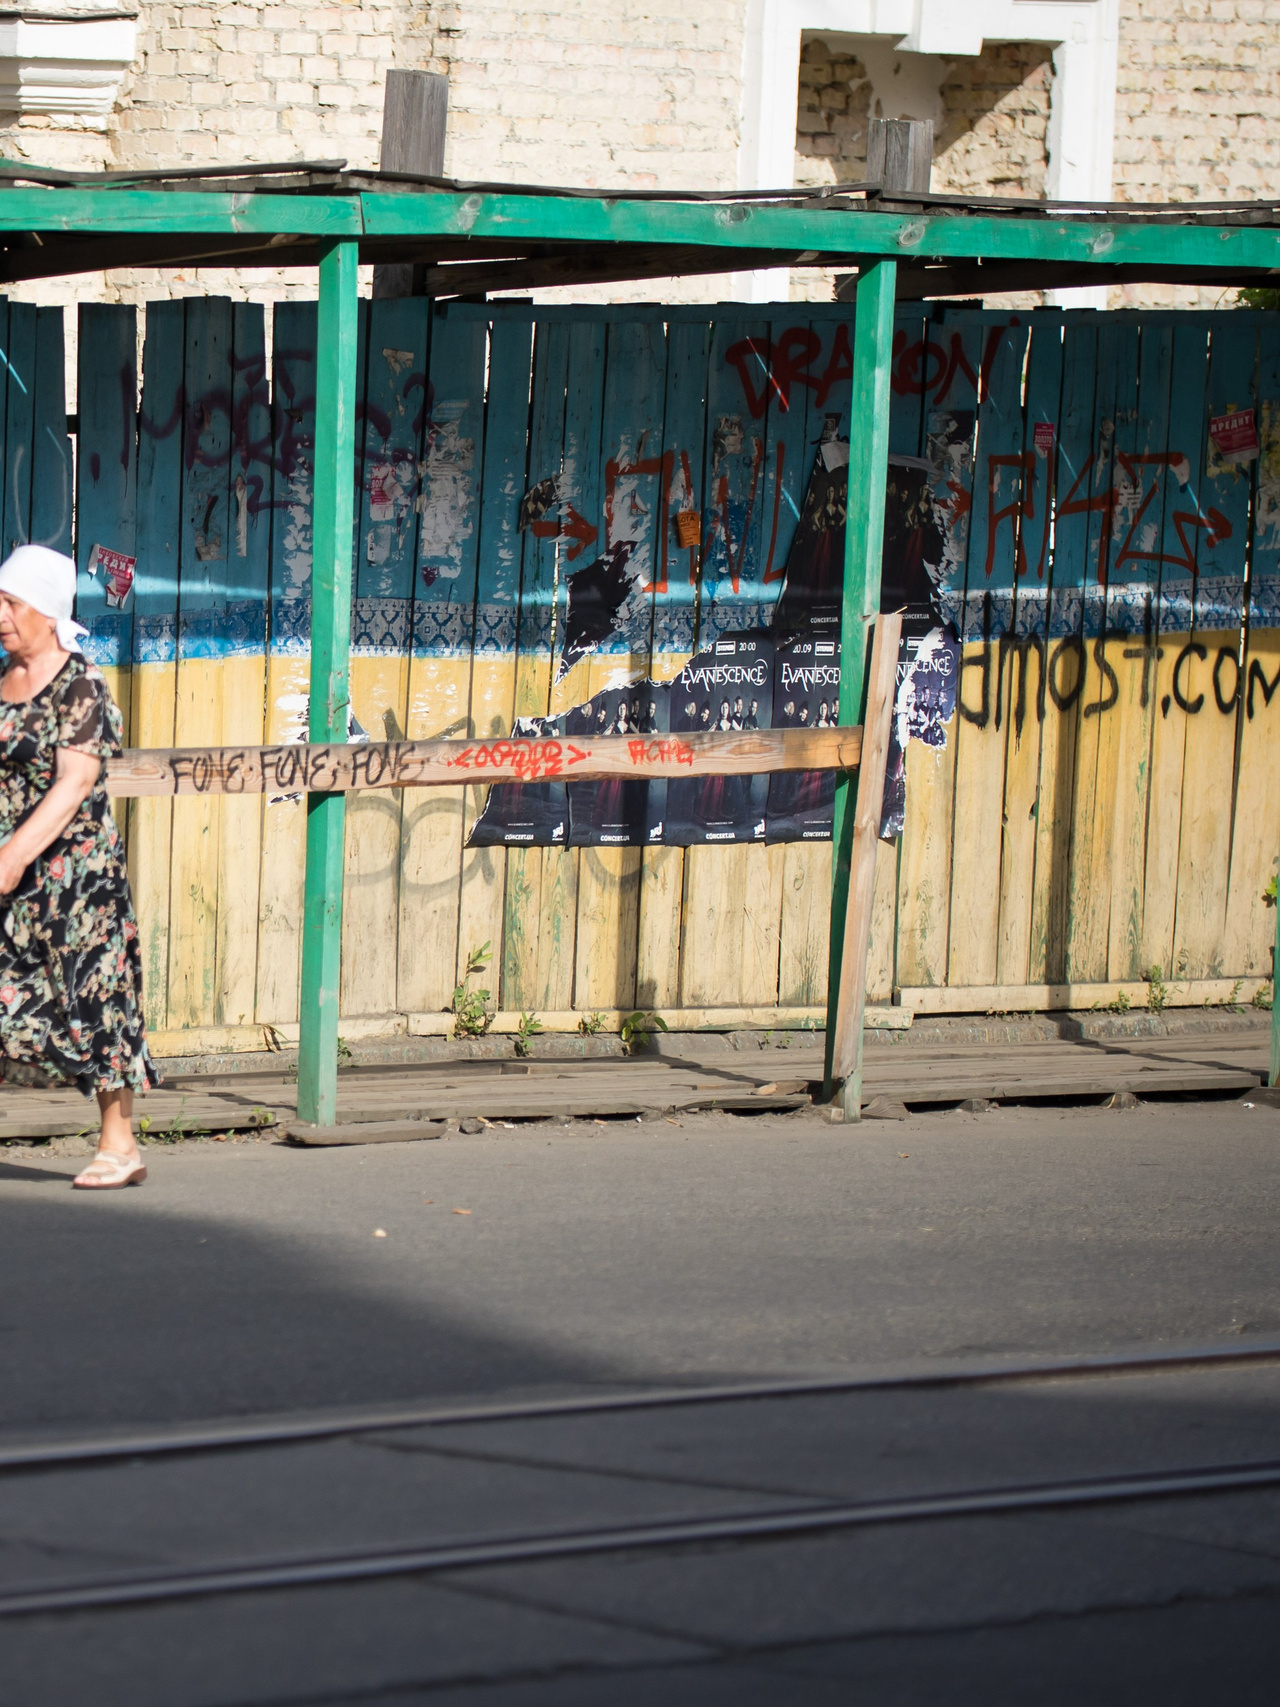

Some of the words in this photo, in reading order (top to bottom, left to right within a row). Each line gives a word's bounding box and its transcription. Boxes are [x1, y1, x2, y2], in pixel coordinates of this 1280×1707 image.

[1211, 415, 1250, 433] КРЕДИТ
[98, 553, 134, 573] РЕДИТ
[681, 660, 768, 692] EVANESCENCE
